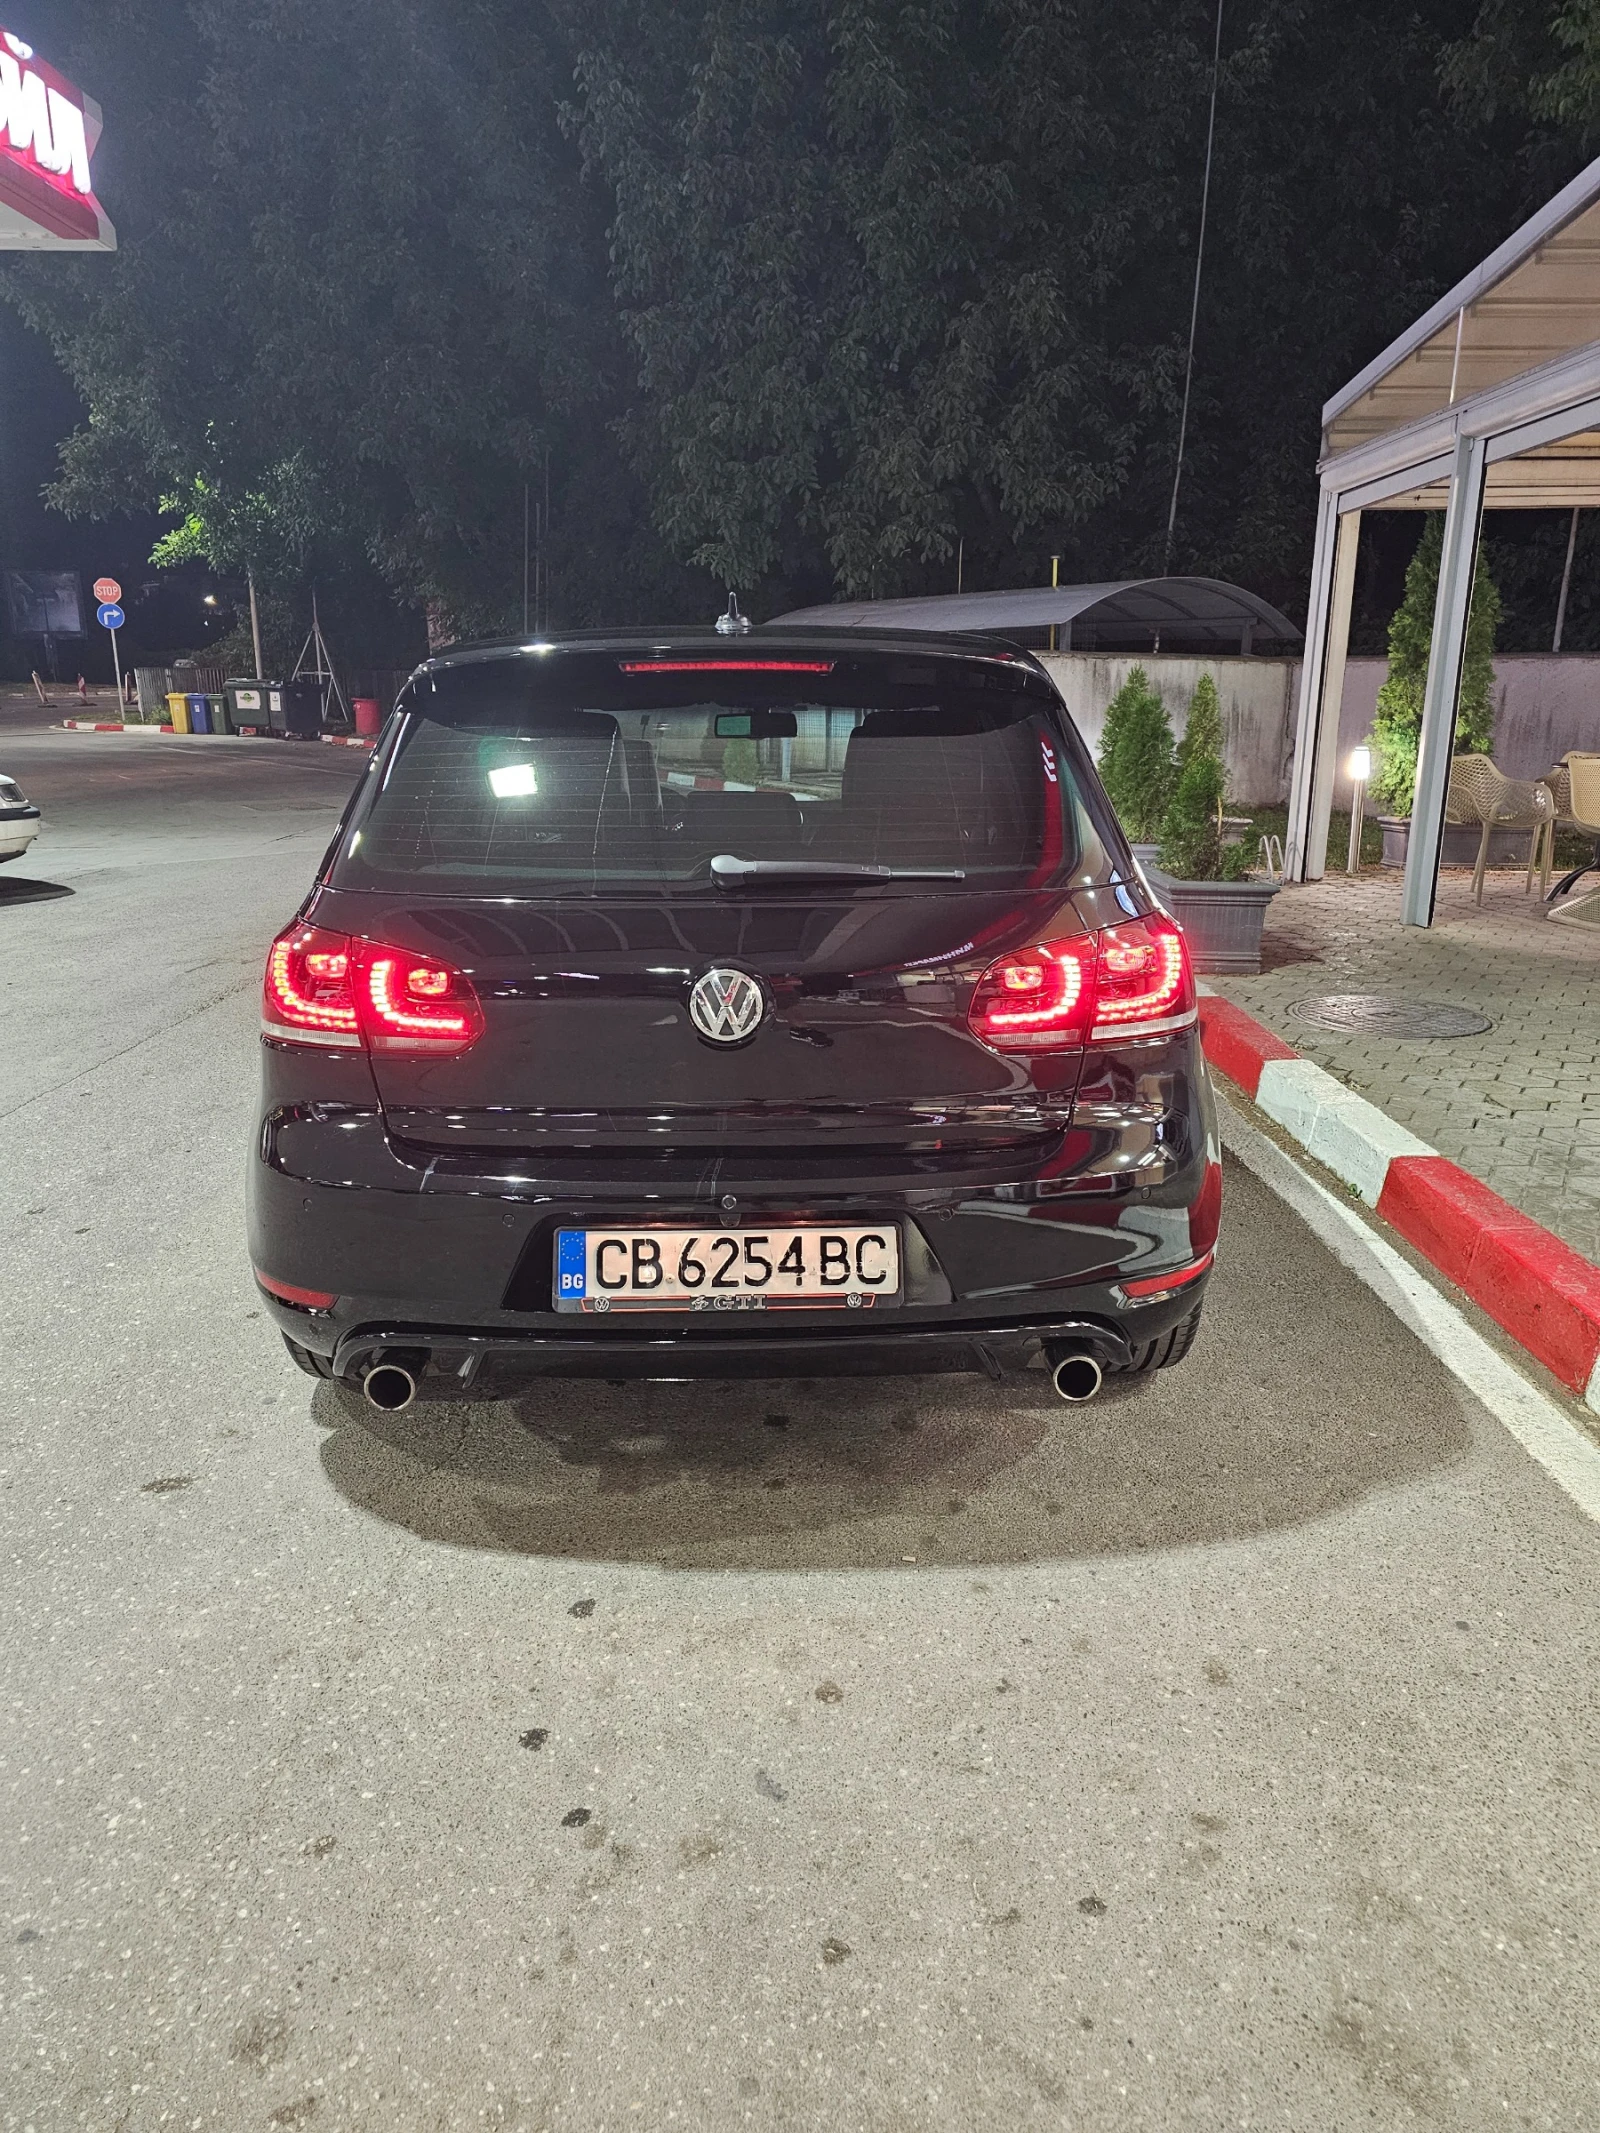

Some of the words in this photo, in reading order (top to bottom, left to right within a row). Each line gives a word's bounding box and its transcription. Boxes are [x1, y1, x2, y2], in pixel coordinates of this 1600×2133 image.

[0, 30, 92, 194] ЙЛ
[96, 586, 118, 596] STOP
[689, 968, 764, 1042] VW
[596, 1238, 663, 1289] CB
[678, 1236, 806, 1289] 6254
[819, 1234, 887, 1286] BC
[562, 1273, 584, 1290] BG
[713, 1294, 766, 1310] GTI
